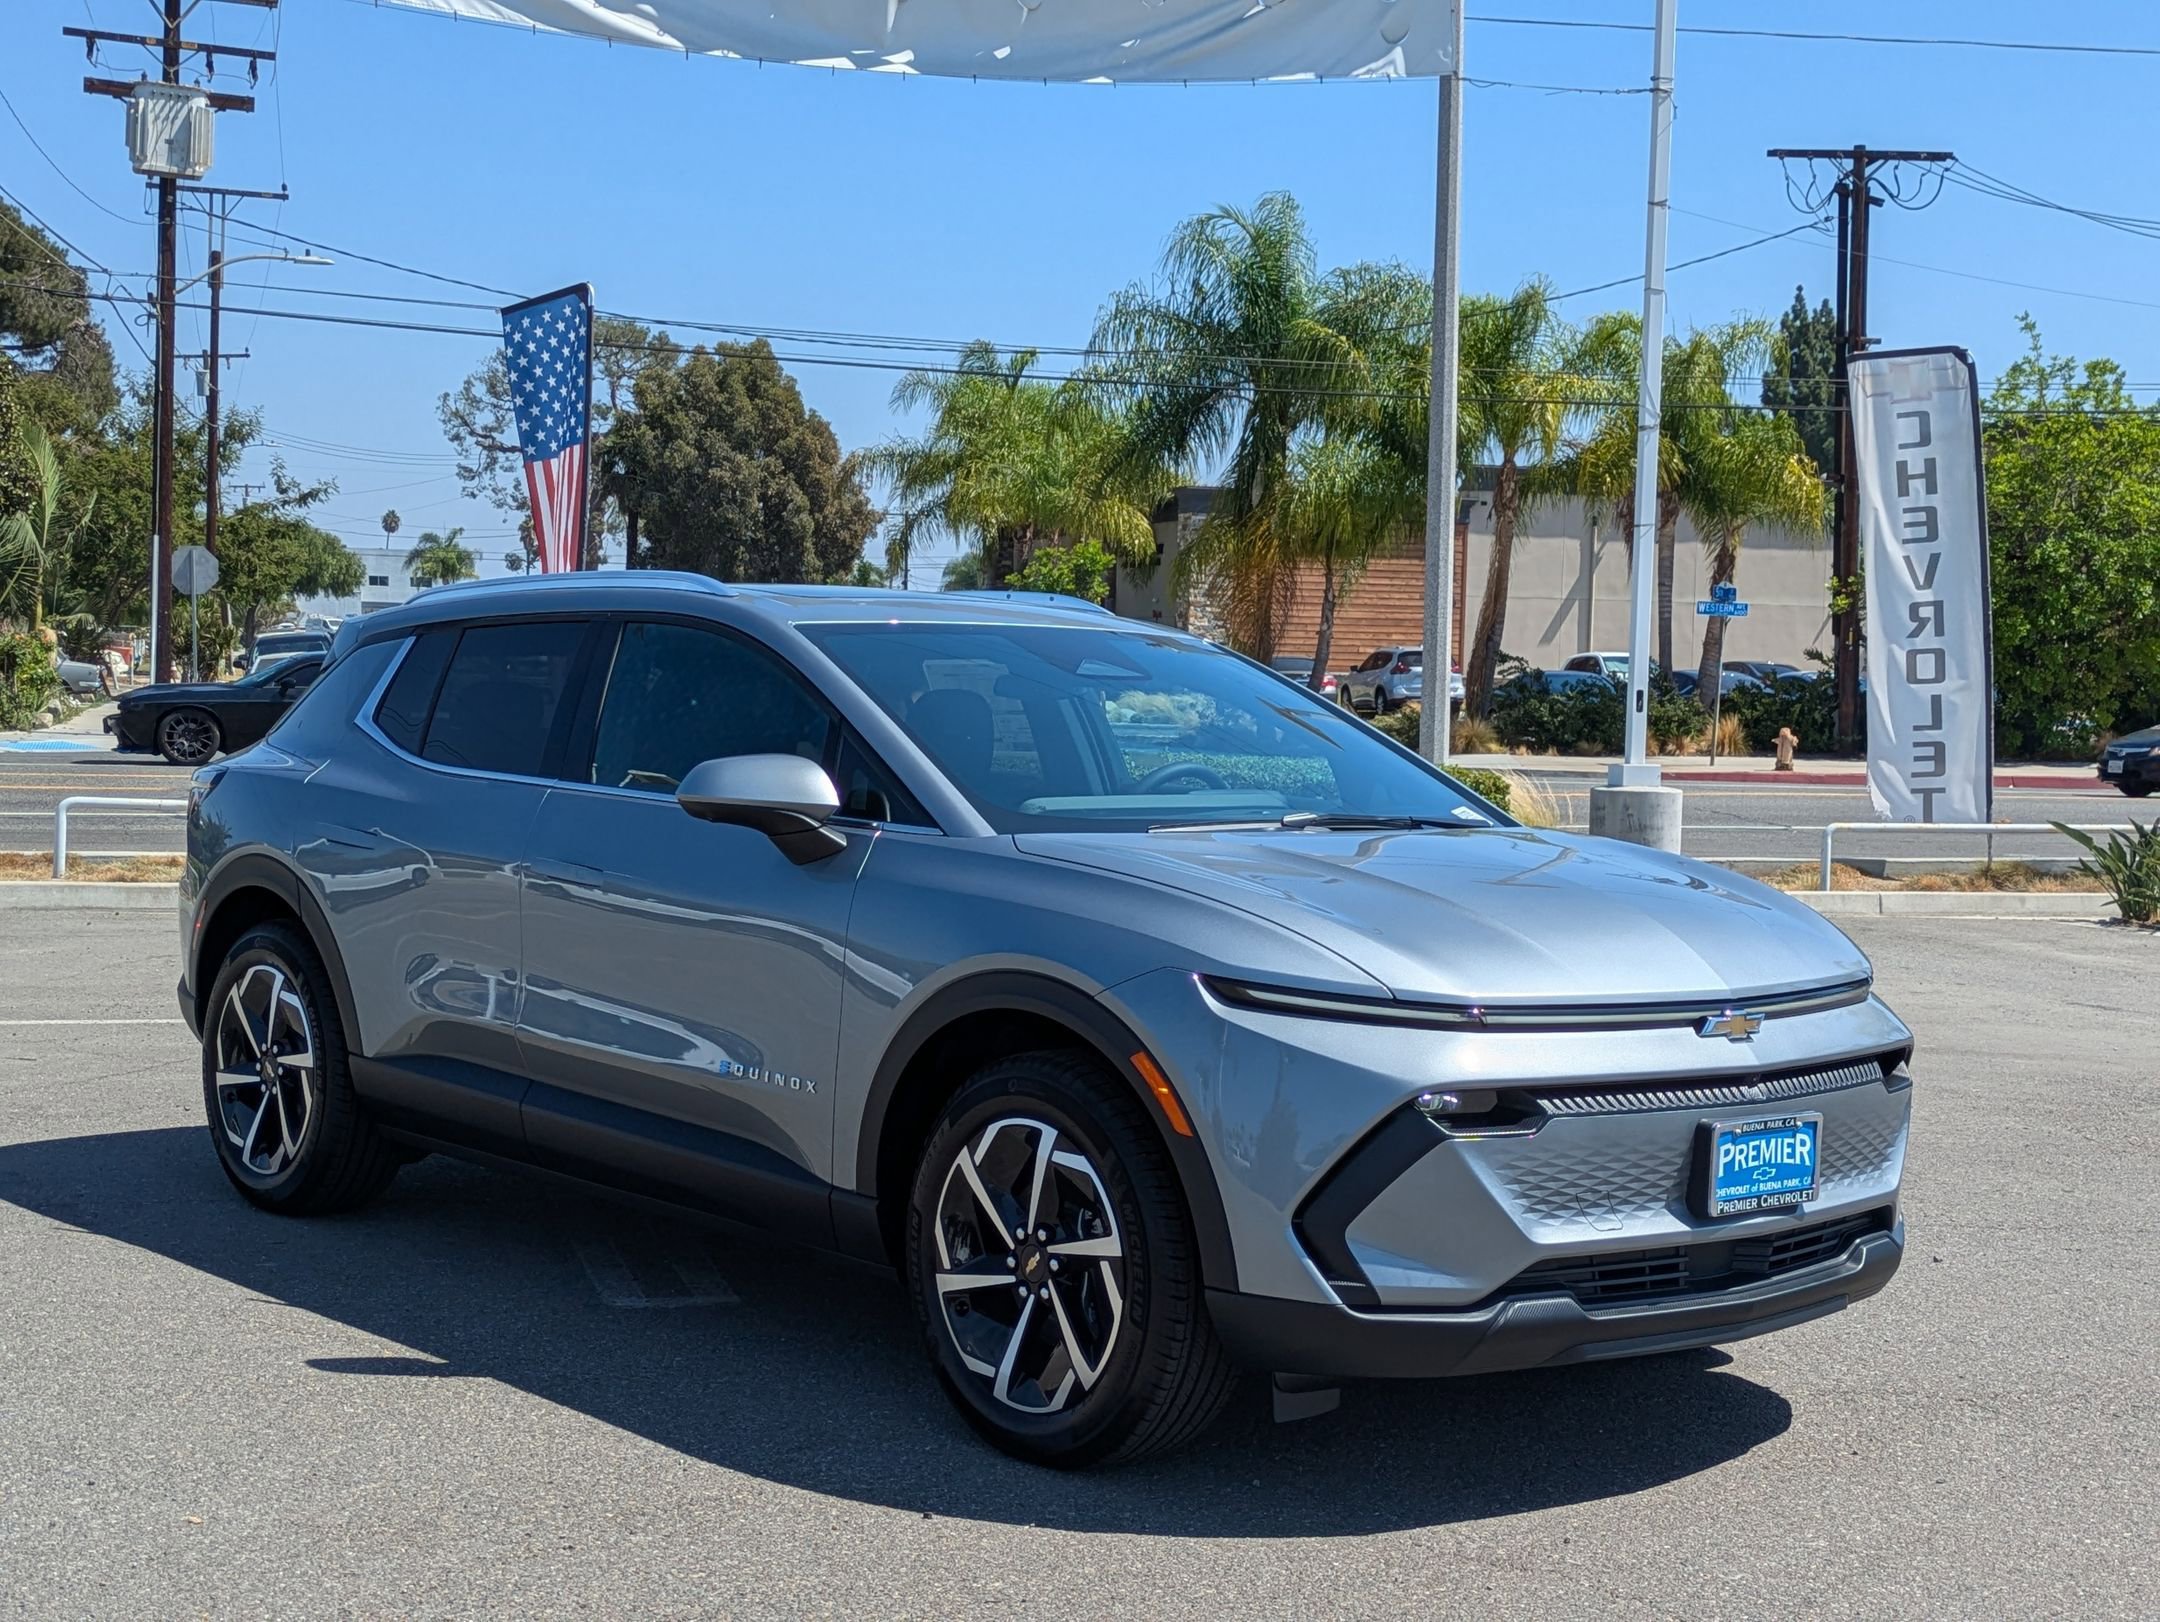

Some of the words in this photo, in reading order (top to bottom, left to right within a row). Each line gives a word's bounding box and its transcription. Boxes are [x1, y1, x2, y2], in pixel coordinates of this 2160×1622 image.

[1699, 603, 1734, 613] WESTERN
[720, 1060, 816, 1094] EQUINOX
[1743, 1122, 1765, 1132] BUENA
[1785, 1119, 1795, 1127] CA
[1718, 1133, 1811, 1178] PREMIER
[1751, 1183, 1759, 1192] of
[1759, 1181, 1782, 1191] BUENA
[1803, 1176, 1812, 1184] CA
[1717, 1198, 1758, 1214] PREMIER
[1761, 1189, 1814, 1207] CHEVROLET
[1120, 1202, 1146, 1327] MICHELIN
